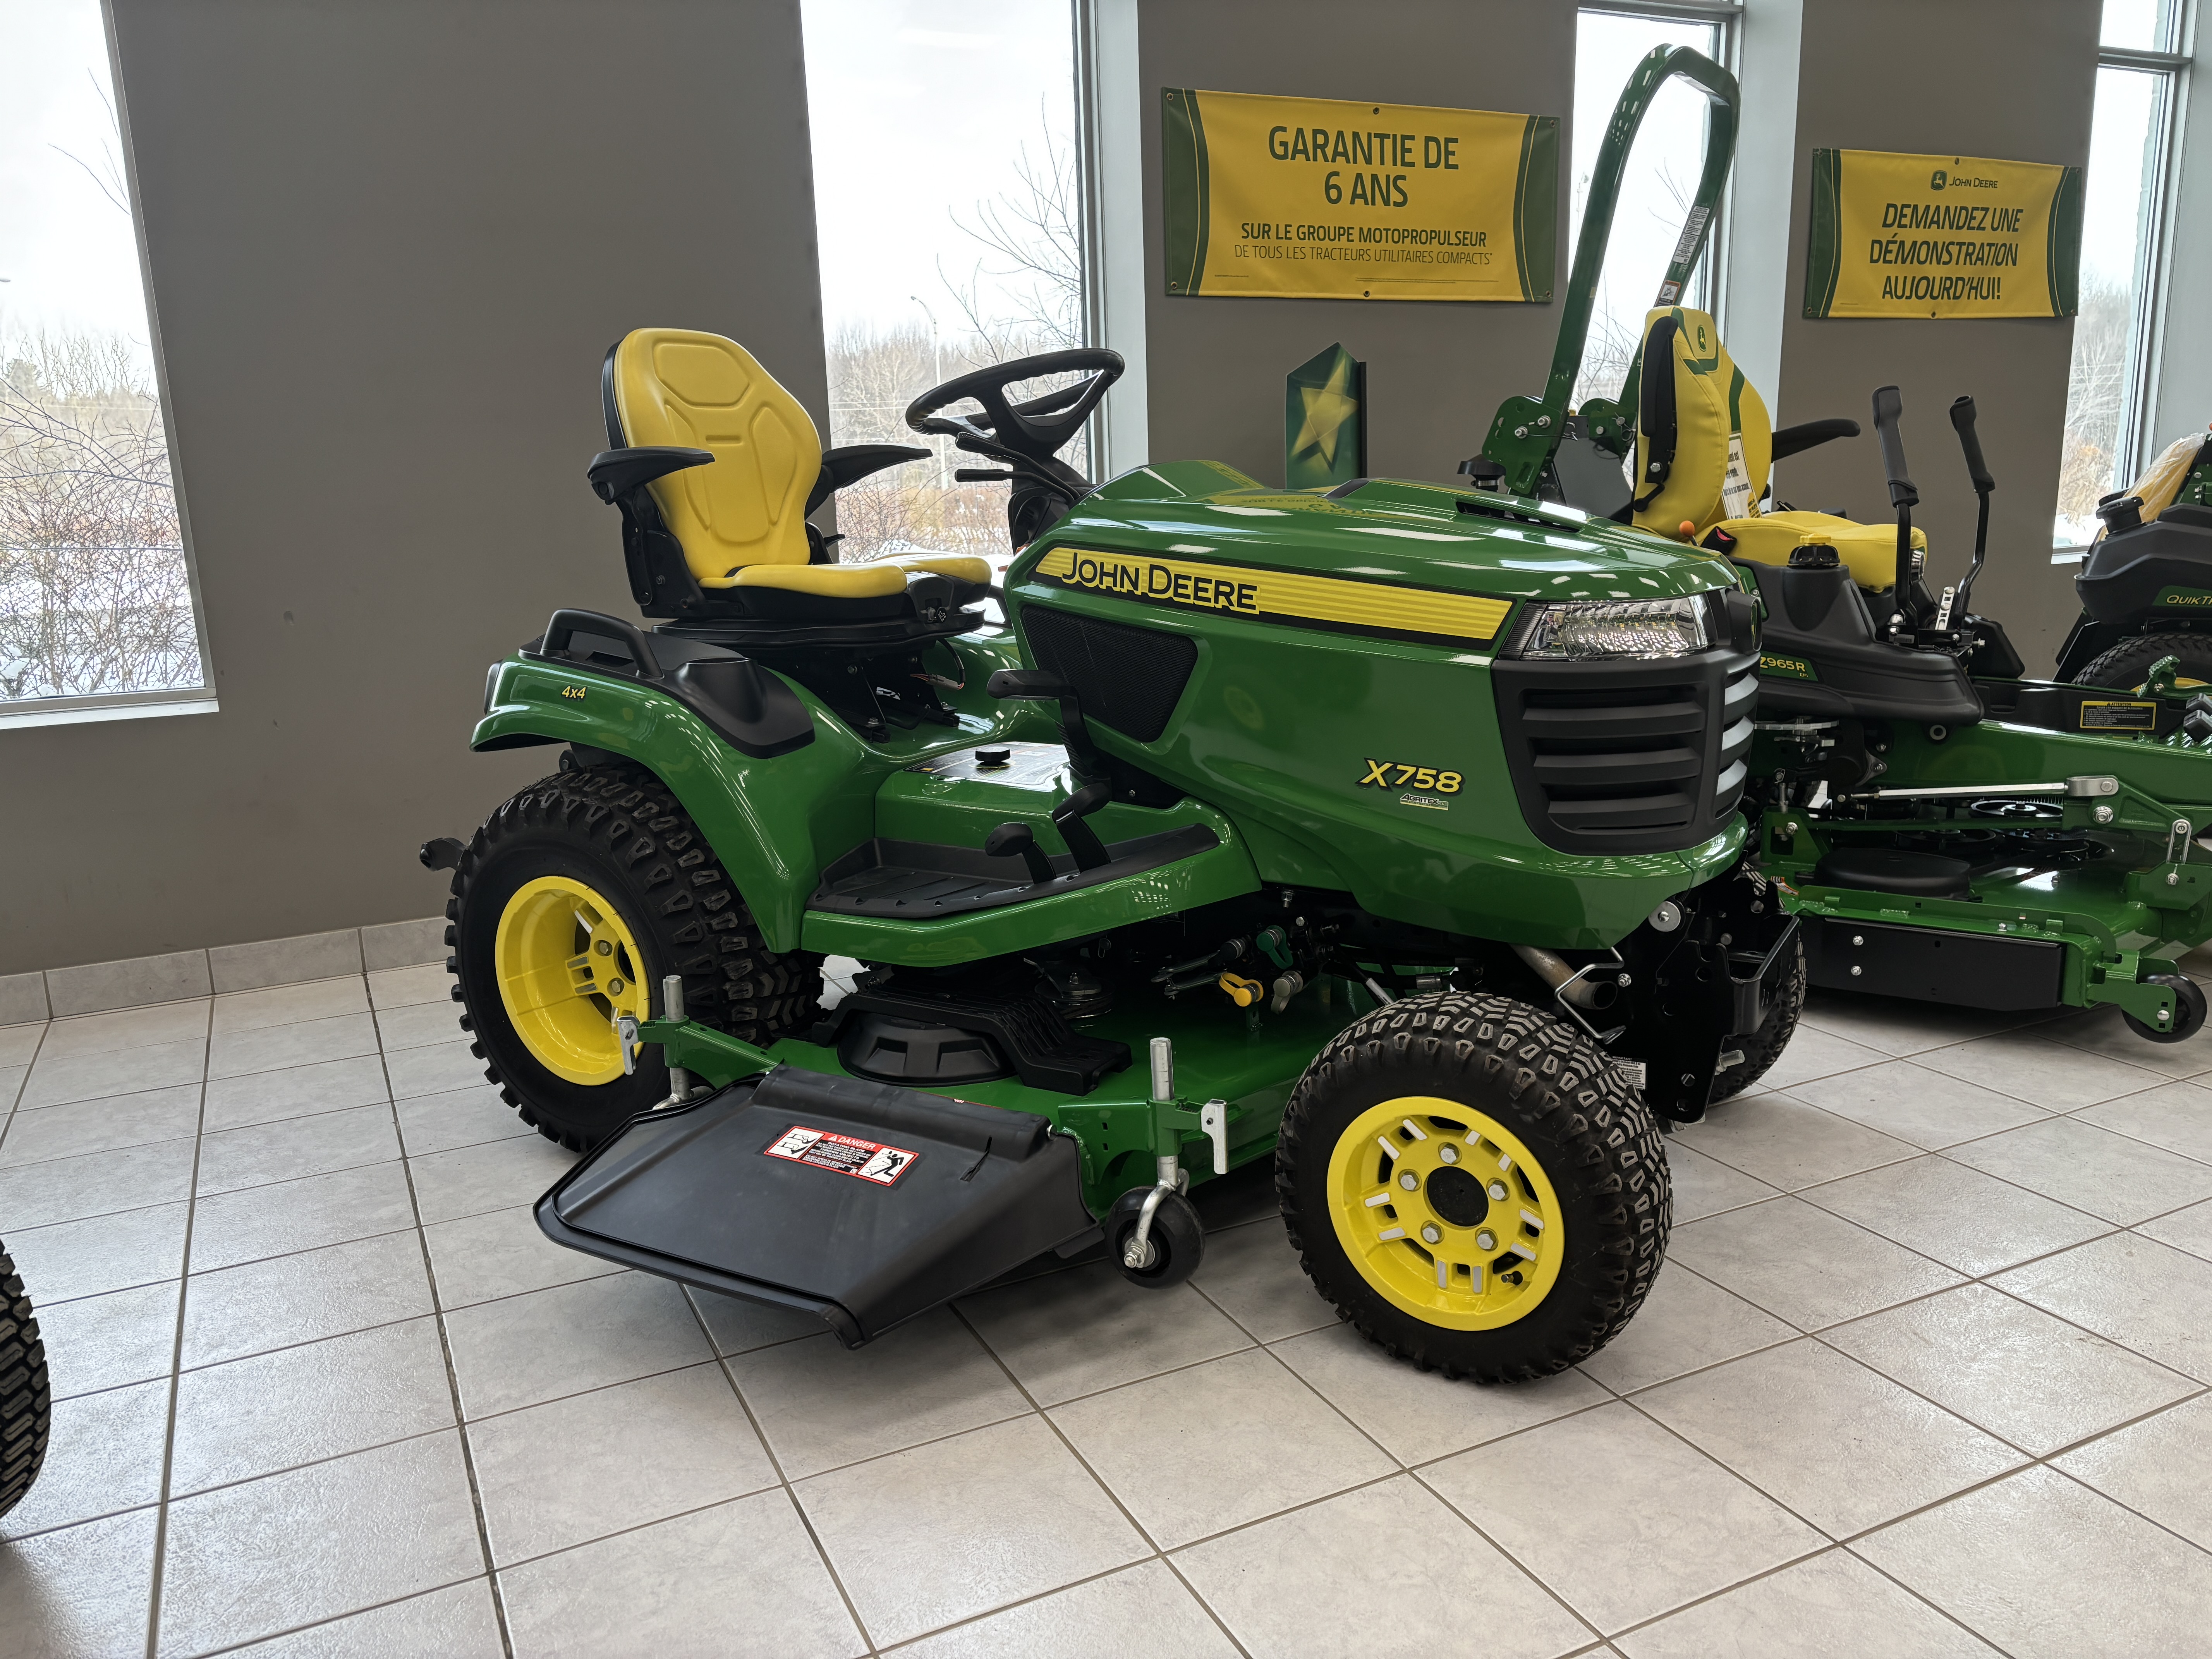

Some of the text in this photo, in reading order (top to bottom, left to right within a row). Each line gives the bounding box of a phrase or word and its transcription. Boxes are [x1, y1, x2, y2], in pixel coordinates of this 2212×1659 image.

[1269, 126, 1459, 170] GARANTIE DE
[1324, 171, 1408, 208] 6 ANS
[1949, 177, 1998, 189] JOHN DEERE
[1882, 203, 2024, 232] DEMANDEZ UNE
[1241, 223, 1487, 247] SUR LE GROUPE MOTOPROPULSEUR
[1235, 244, 1249, 258] DE
[1252, 246, 1283, 259] TOUS
[1286, 246, 1307, 259] LES
[1309, 247, 1371, 261] TRACTEURS
[1375, 249, 1433, 263] UTILITAIRES
[1869, 233, 2018, 266] DÉMONSTRATION
[1882, 276, 2001, 301] AUJOURD'HUI!
[1062, 552, 1257, 611] JOHN DEERE
[562, 685, 586, 699] 4x4
[1358, 759, 1462, 793] X758
[1401, 794, 1439, 804] AGRITEX
[838, 1137, 876, 1150] DANGER
